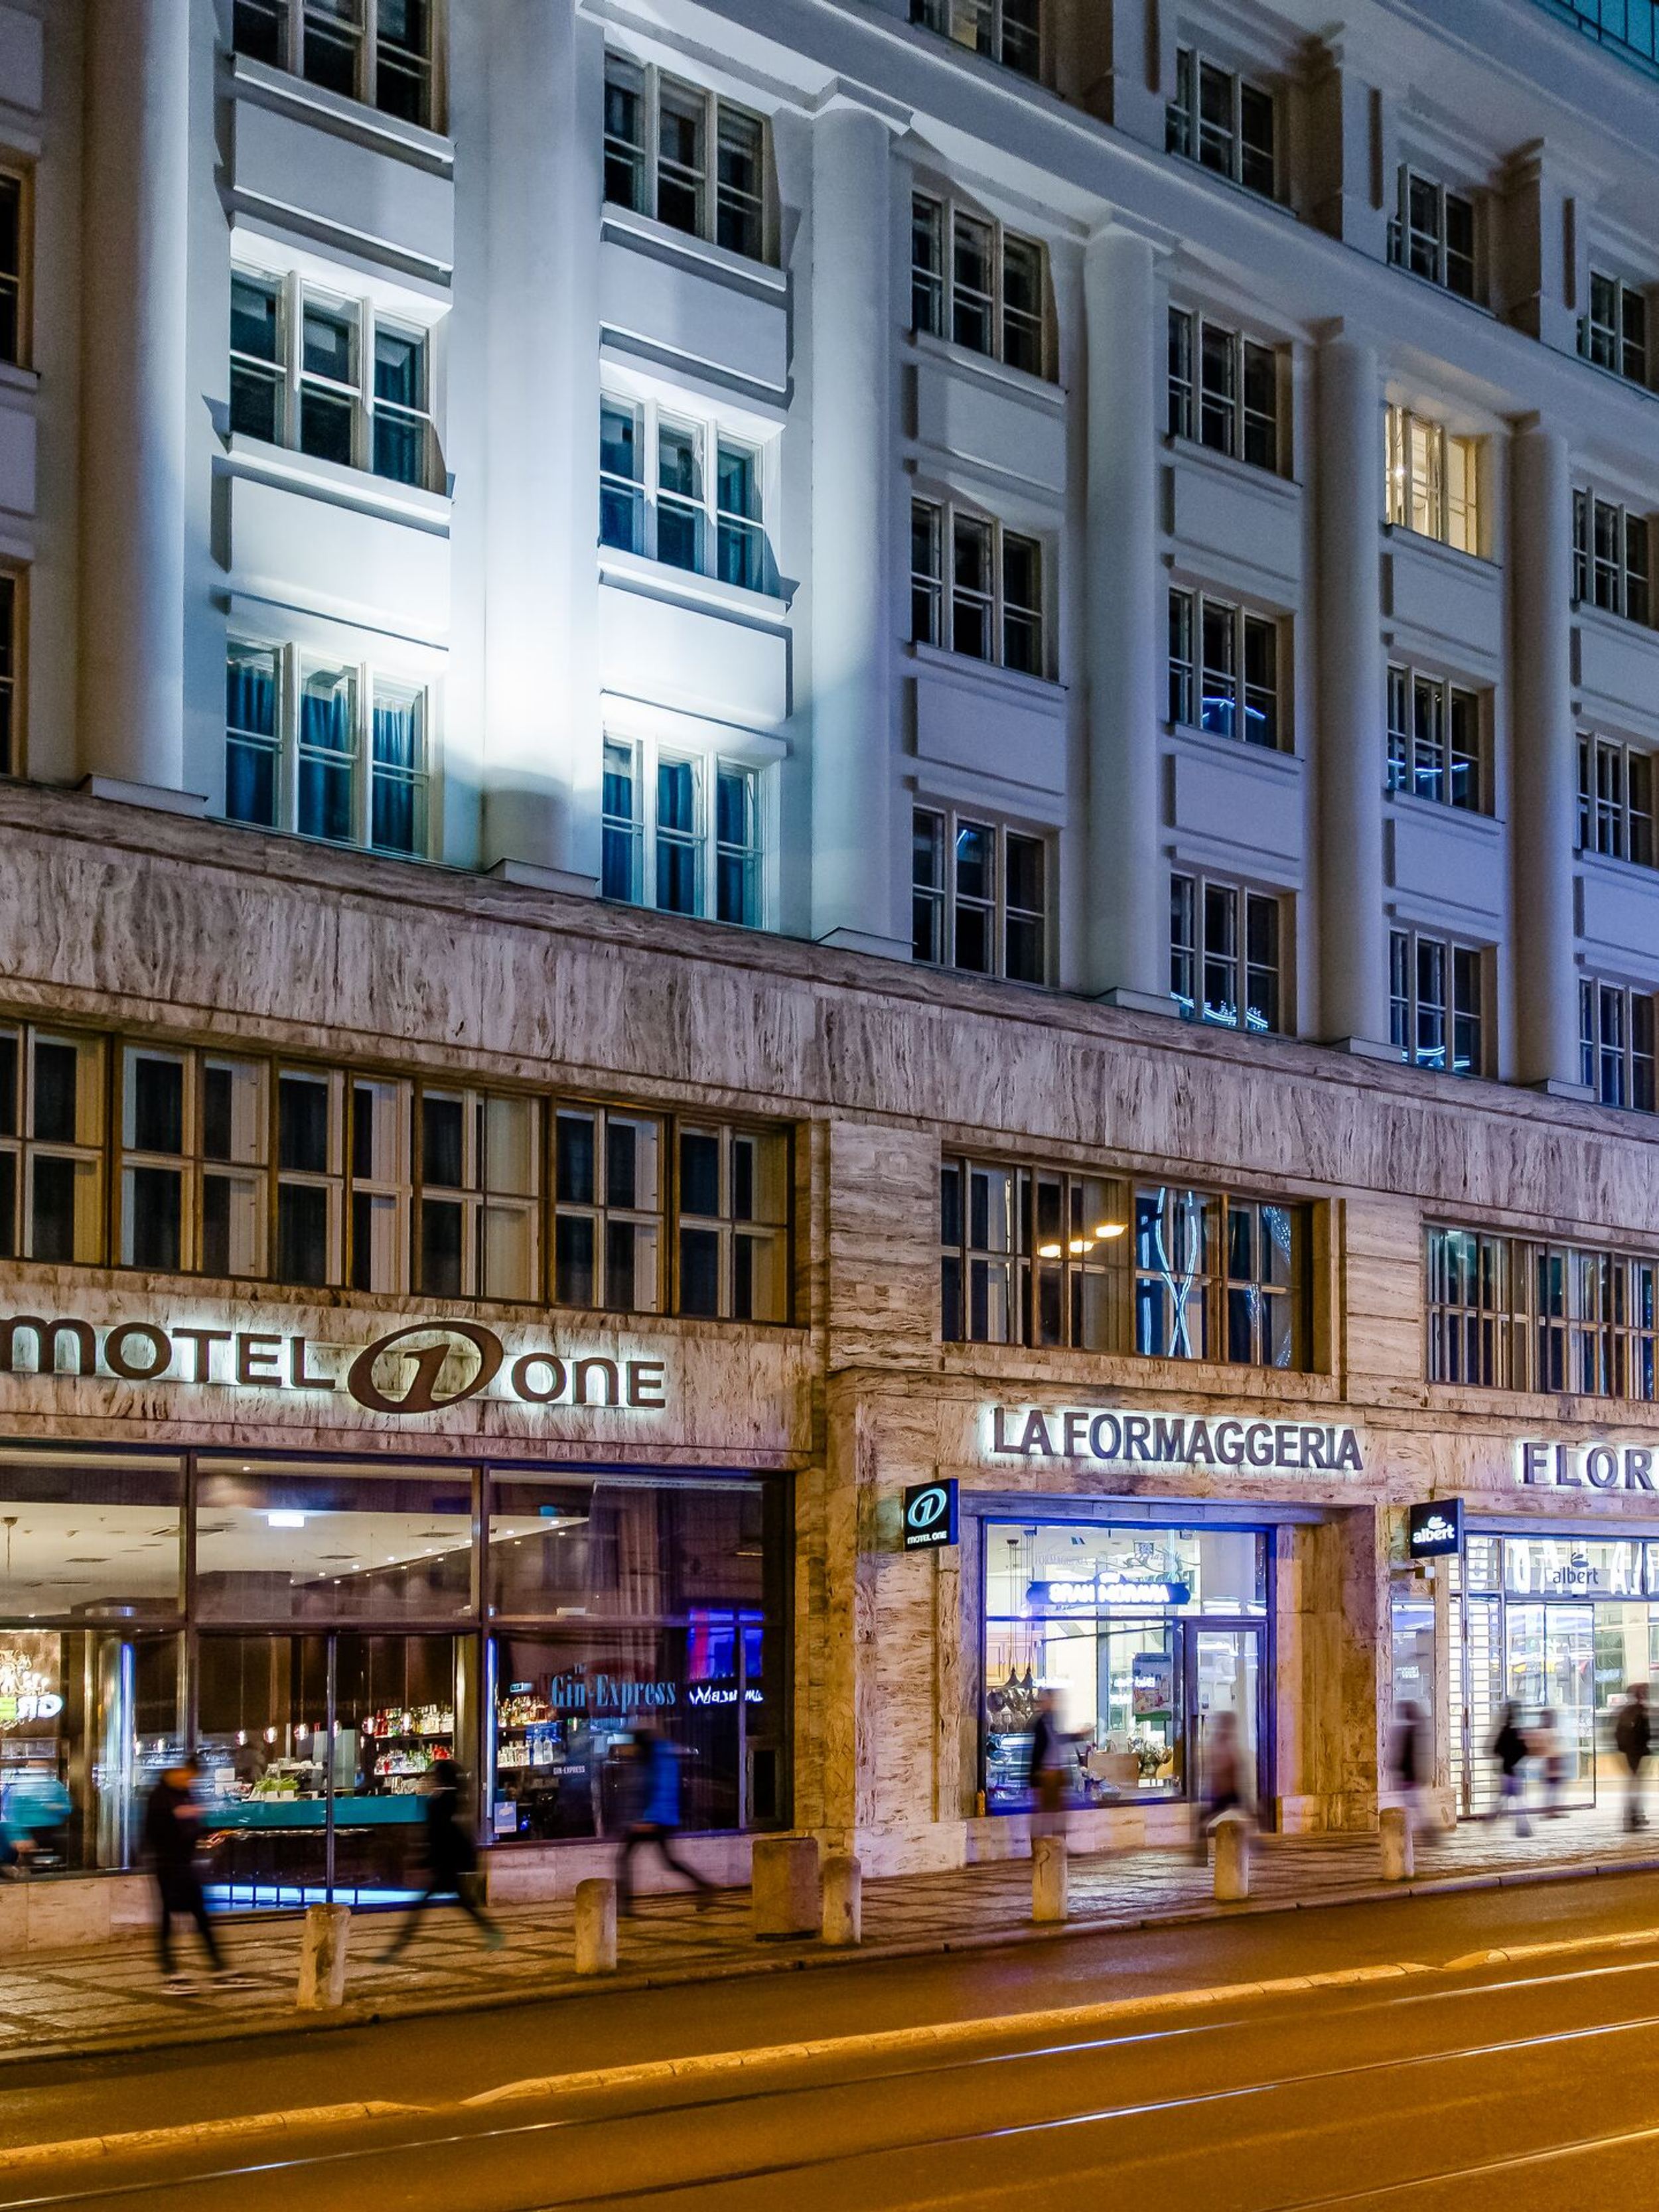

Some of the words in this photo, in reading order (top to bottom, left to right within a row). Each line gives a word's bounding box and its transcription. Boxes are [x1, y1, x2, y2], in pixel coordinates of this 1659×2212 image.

[993, 1407, 1053, 1456] LA
[1063, 1411, 1364, 1471] FORMAGGERIA
[1523, 1442, 1656, 1490] FLOR
[1412, 1524, 1455, 1543] albert
[1552, 1566, 1599, 1584] albert
